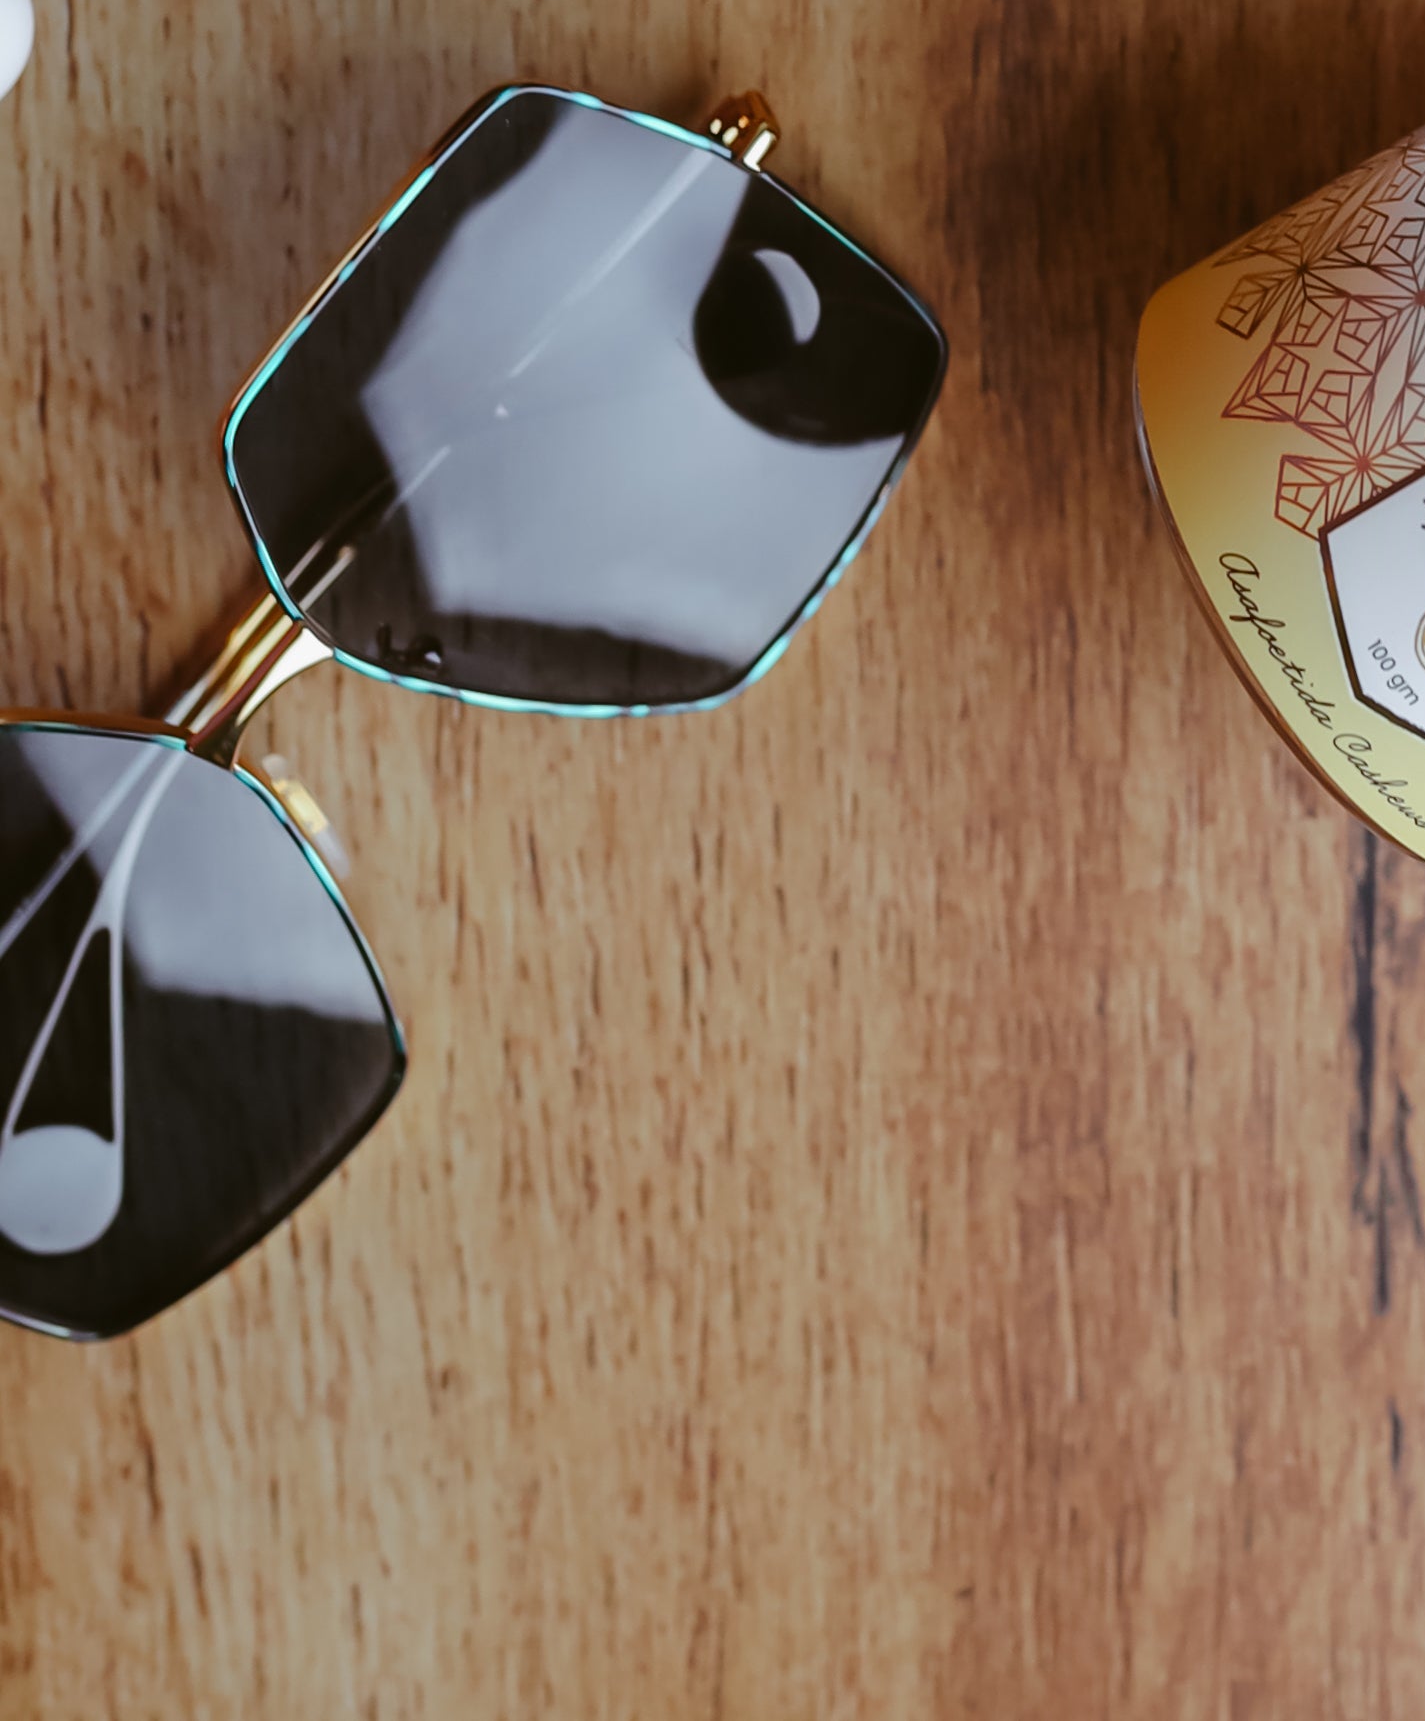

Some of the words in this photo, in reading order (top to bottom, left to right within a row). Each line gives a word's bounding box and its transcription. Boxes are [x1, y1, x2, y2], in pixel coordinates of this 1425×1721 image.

[1218, 552, 1335, 730] Asafoetida
[1368, 638, 1396, 671] 100
[1386, 674, 1419, 706] gm
